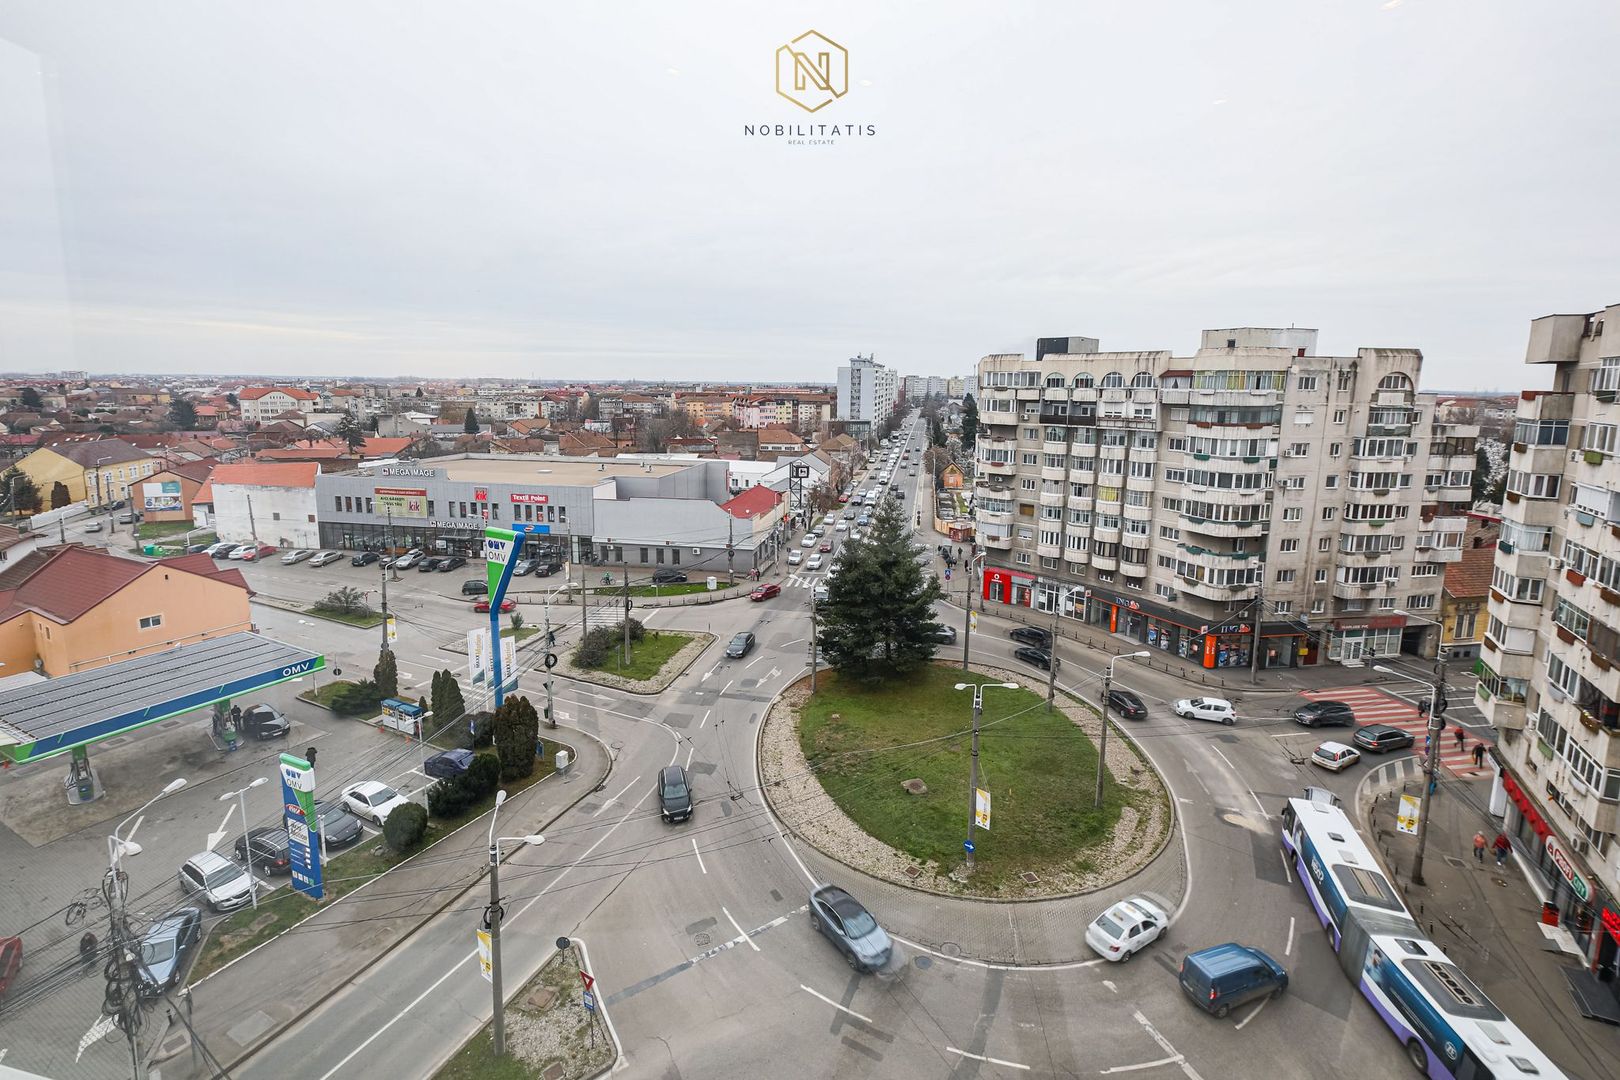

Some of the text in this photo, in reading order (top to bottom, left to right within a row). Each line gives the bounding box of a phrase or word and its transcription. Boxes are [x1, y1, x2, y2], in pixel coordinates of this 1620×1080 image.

[389, 468, 434, 477] MEGA IMAGE
[409, 501, 420, 512] kik
[437, 521, 478, 530] MEGA IMAGE
[488, 551, 506, 562] OMV
[1115, 596, 1129, 607] ING
[1221, 625, 1238, 633] ING
[282, 662, 310, 677] OMV
[287, 778, 302, 790] OMV
[1556, 849, 1573, 881] PROFI
